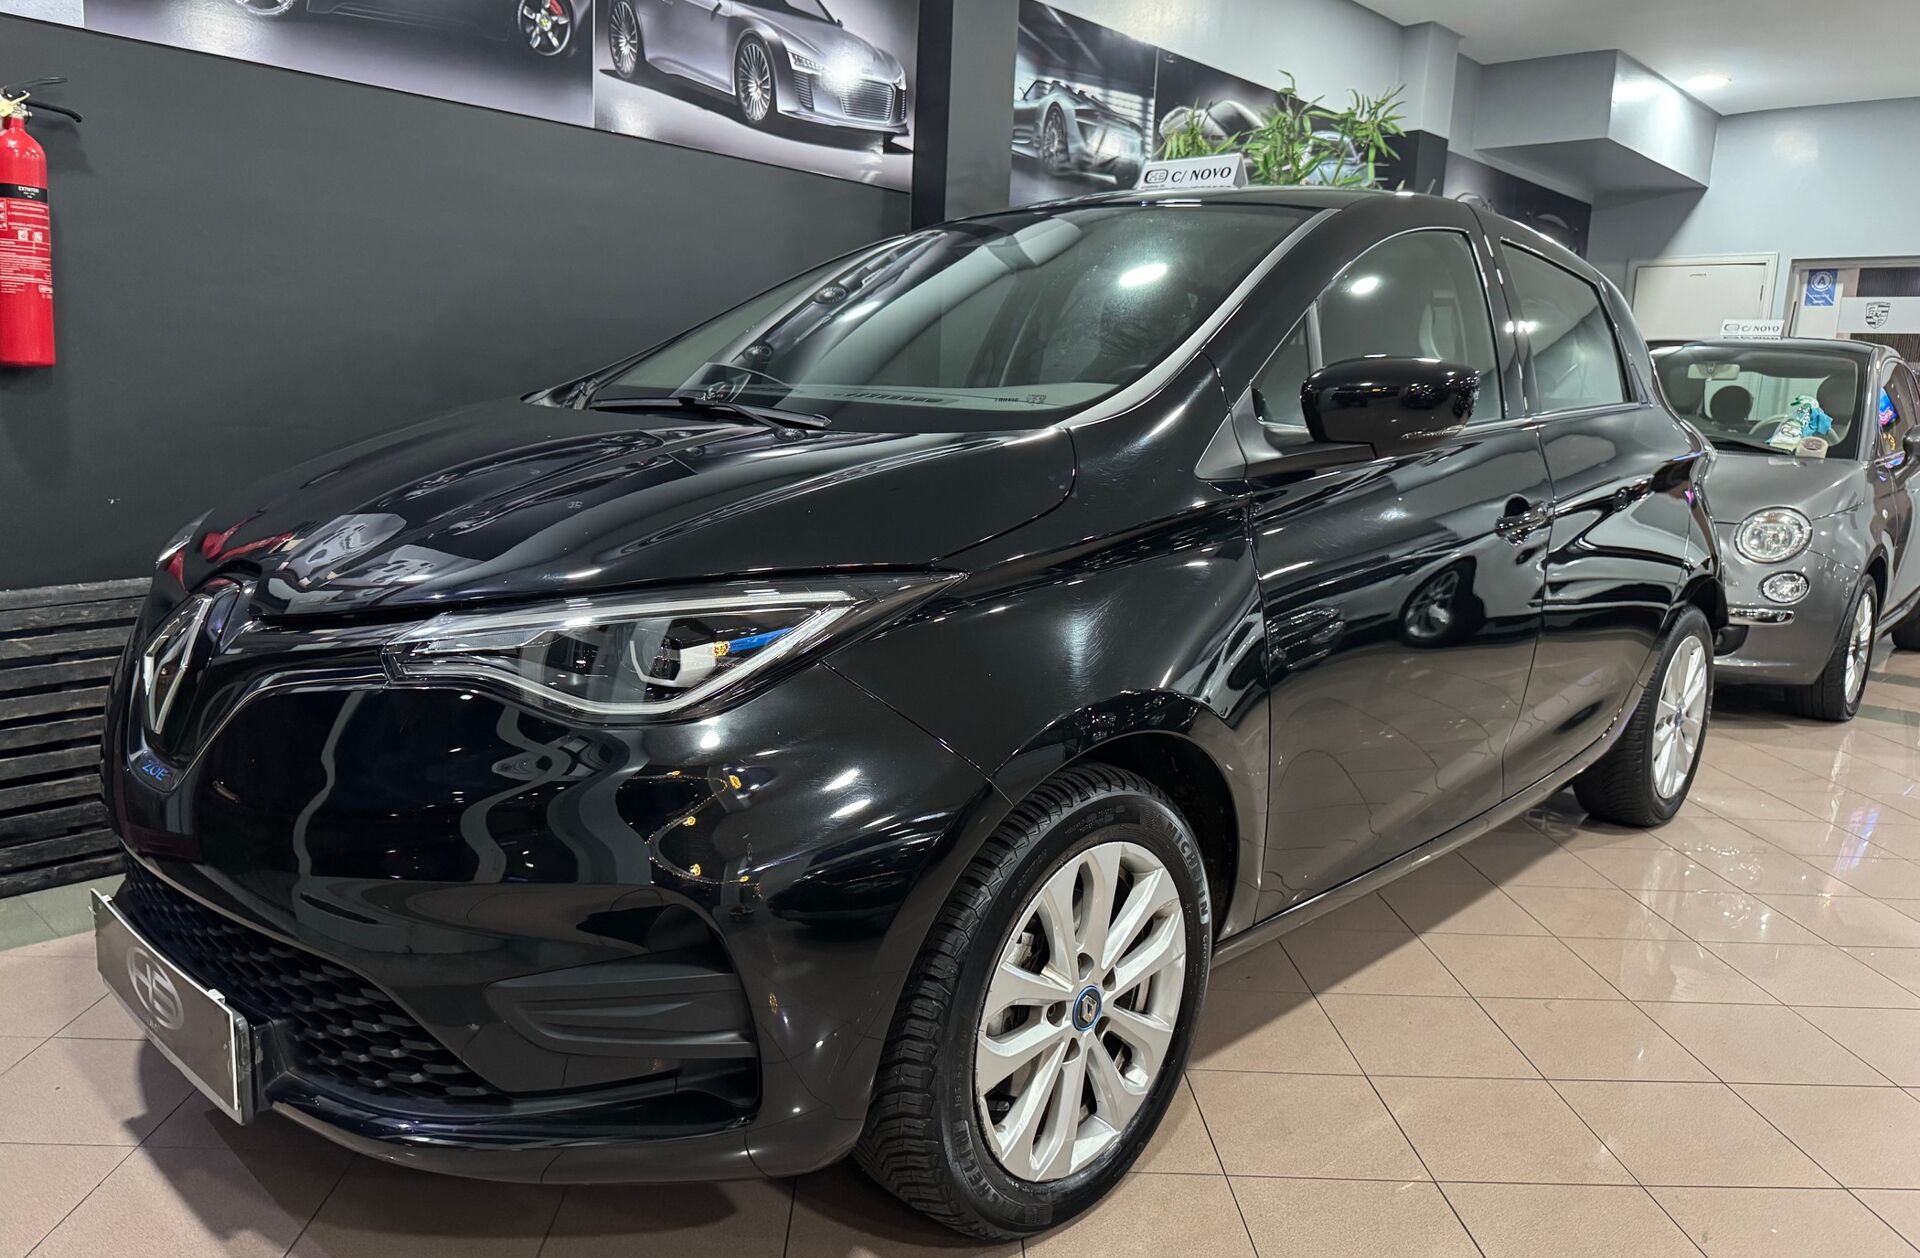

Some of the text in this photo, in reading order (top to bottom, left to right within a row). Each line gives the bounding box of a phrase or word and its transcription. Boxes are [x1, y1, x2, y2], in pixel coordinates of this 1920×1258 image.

[1171, 170, 1187, 183] C/
[1190, 167, 1231, 181] NOVO
[1817, 276, 1826, 285] A
[142, 759, 168, 781] ZOE
